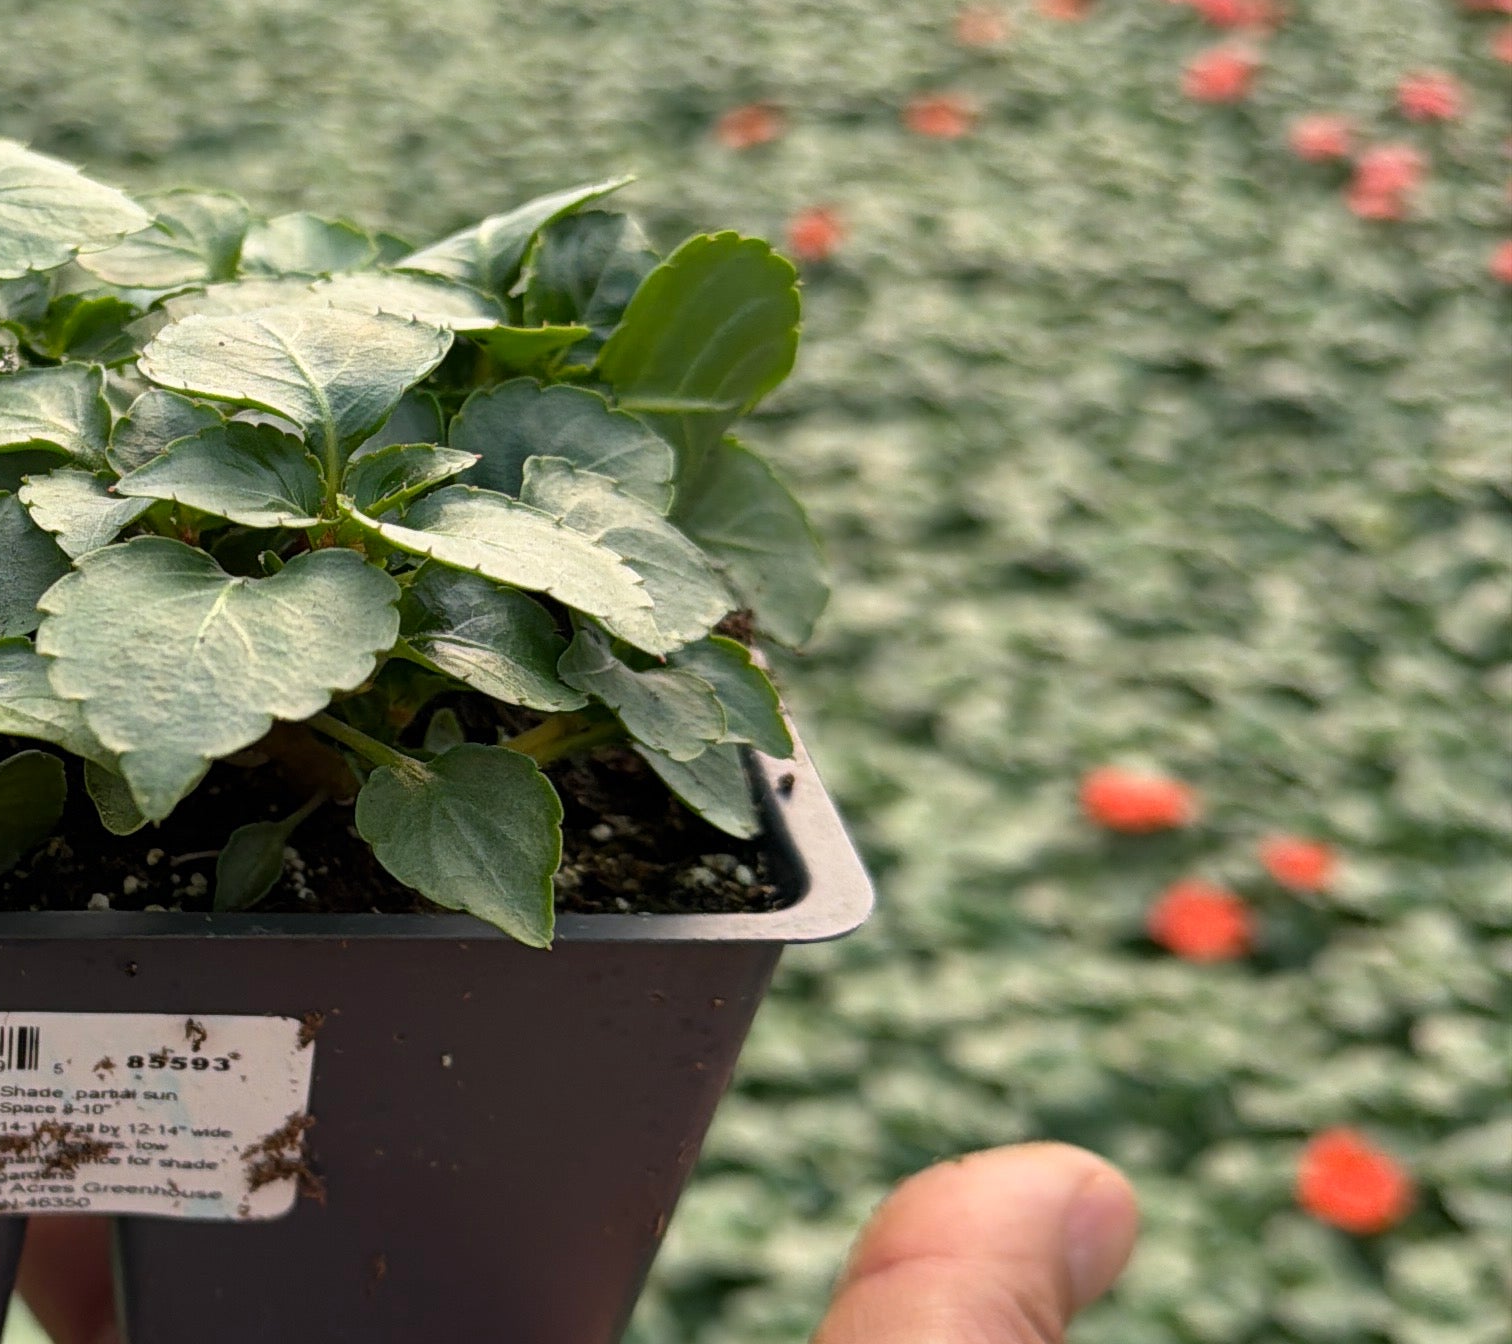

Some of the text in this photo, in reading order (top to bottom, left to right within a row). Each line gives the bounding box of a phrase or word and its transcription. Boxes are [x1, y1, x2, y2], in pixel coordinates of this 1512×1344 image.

[126, 1055, 231, 1072] 85593
[143, 1089, 178, 1102] sun
[0, 1101, 57, 1115] Space
[99, 1122, 120, 1137] by
[191, 1125, 233, 1138] wide
[136, 1140, 169, 1152] low
[127, 1155, 152, 1166] for
[158, 1156, 219, 1170] shade
[10, 1182, 75, 1194] Acres
[83, 1182, 223, 1200] Greenhouse
